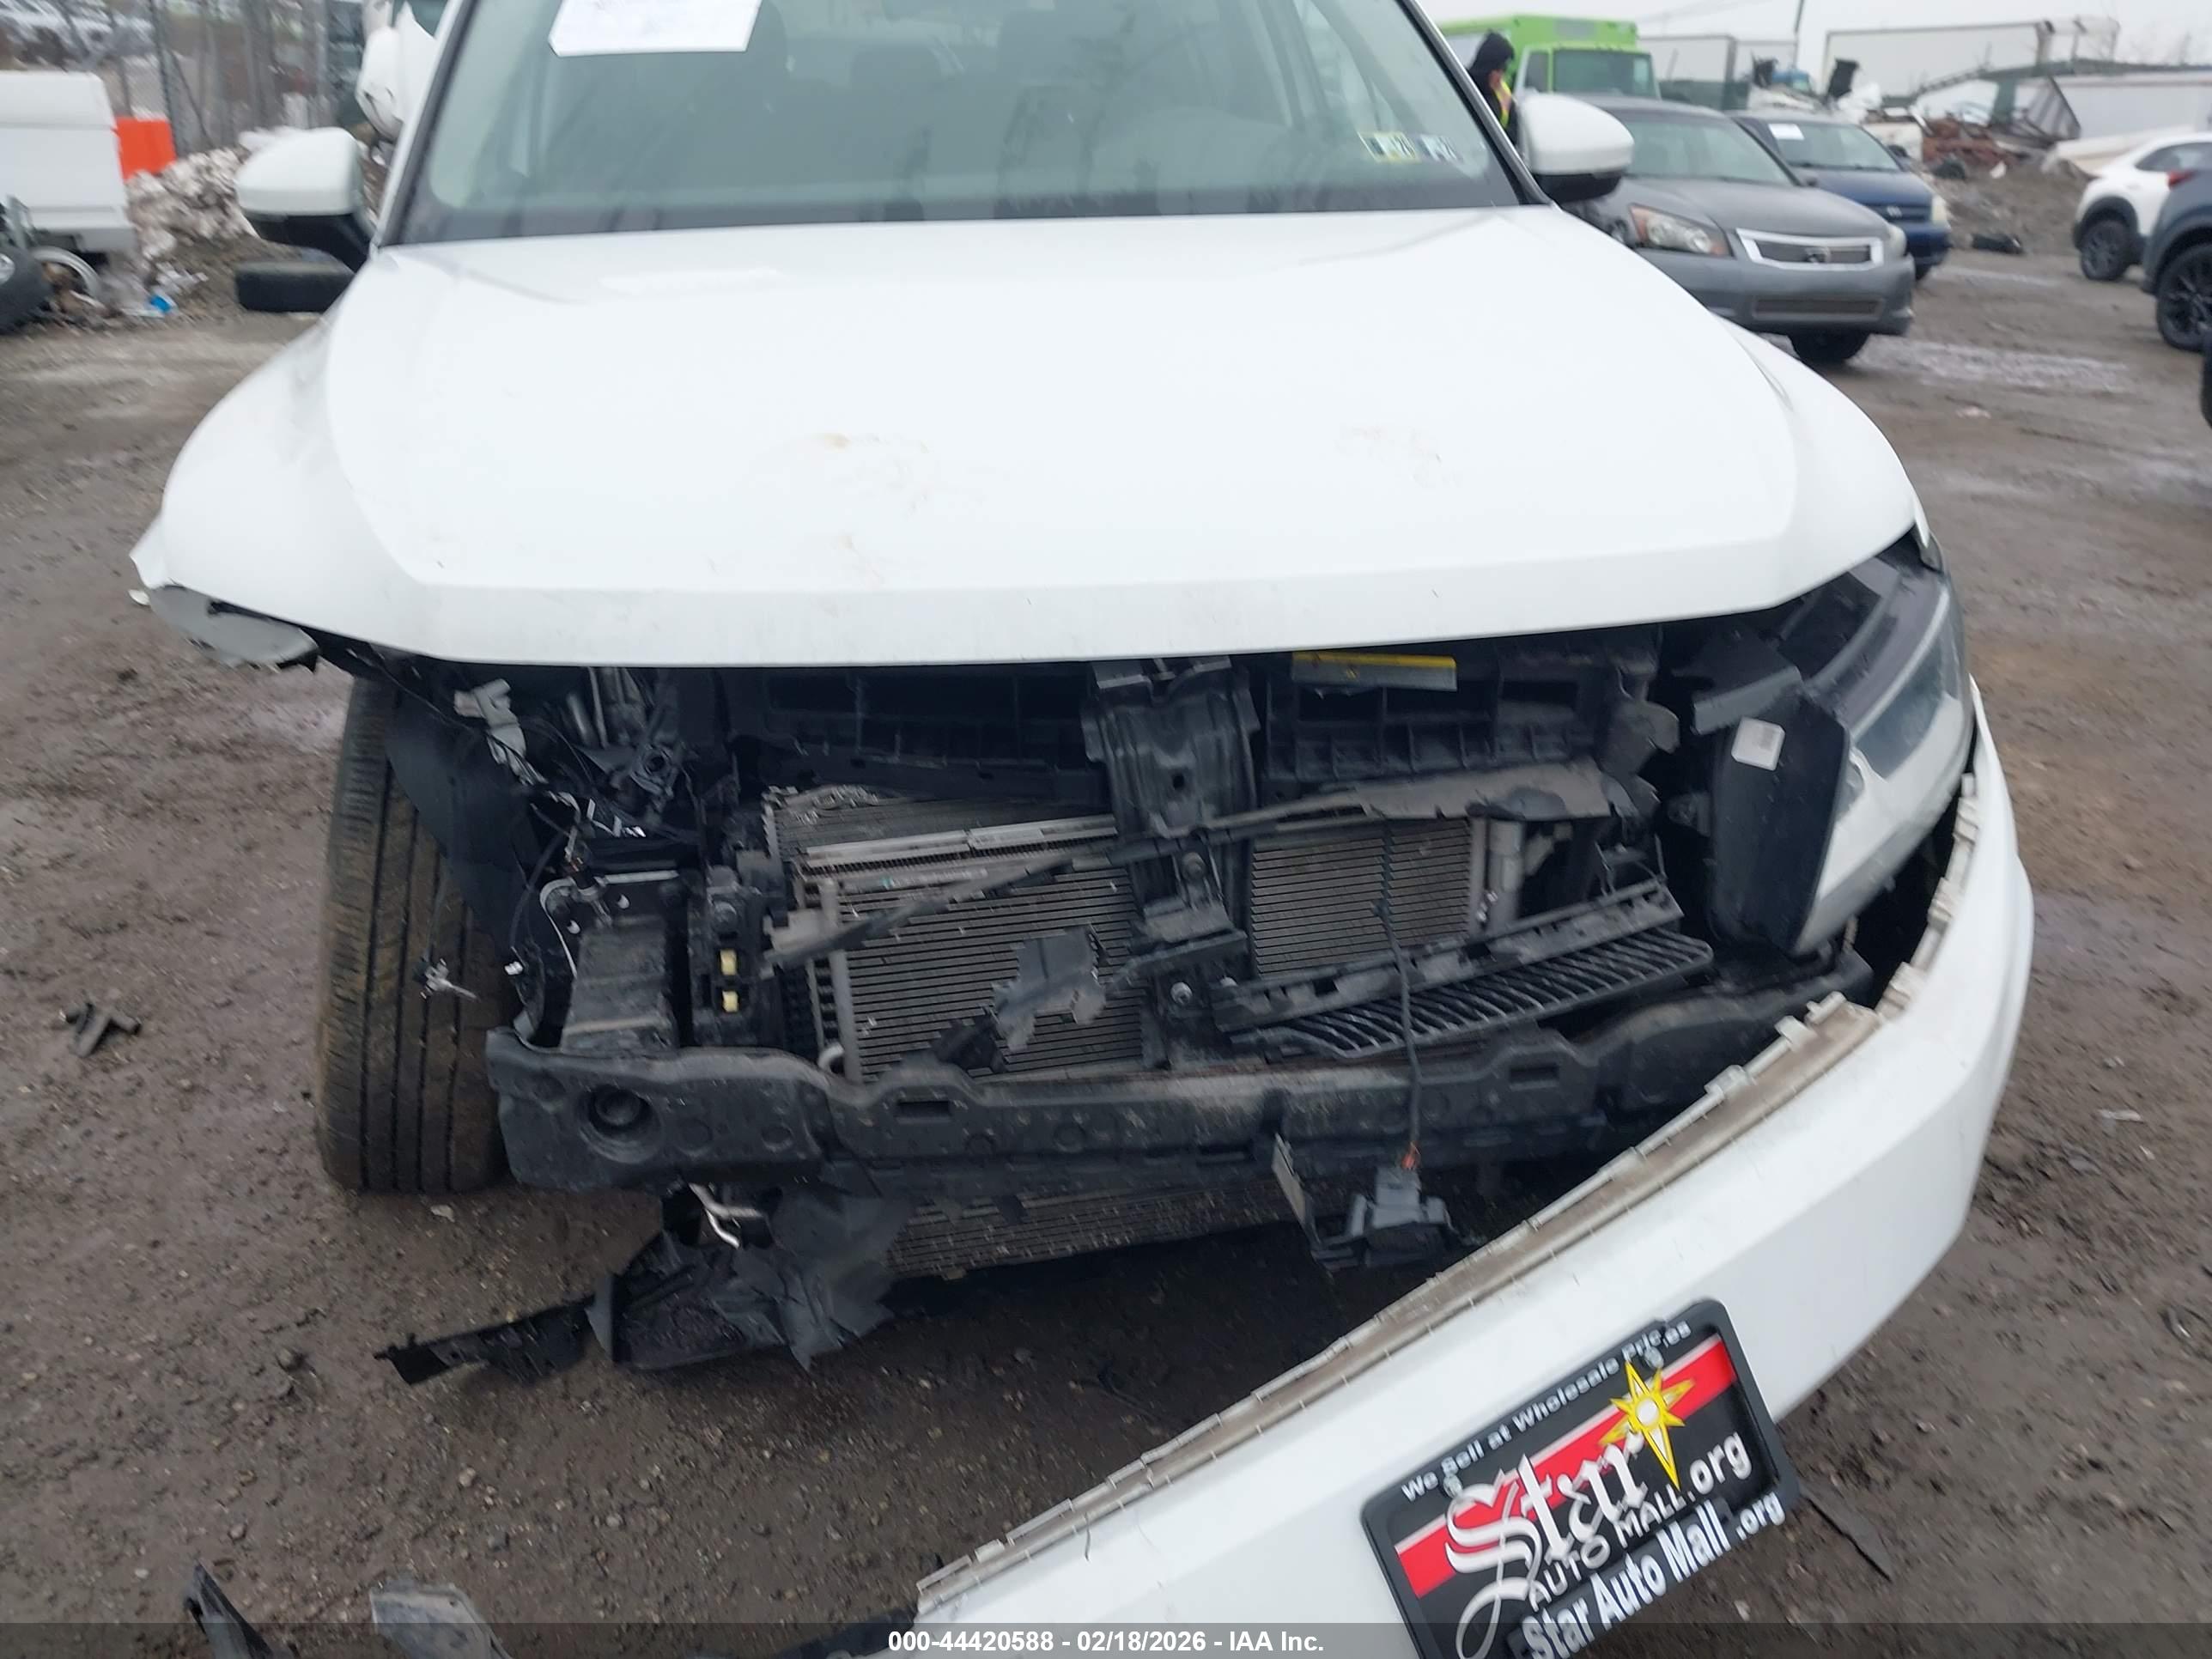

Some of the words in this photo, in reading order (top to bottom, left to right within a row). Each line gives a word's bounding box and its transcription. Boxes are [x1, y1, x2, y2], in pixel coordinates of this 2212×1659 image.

[1401, 1472, 1438, 1502] We
[1487, 1424, 1512, 1449] at
[1512, 1358, 1620, 1432] Wholesale
[1446, 1430, 1646, 1658] Star
[1521, 1597, 1595, 1659] Star
[1590, 1553, 1666, 1631] Auto
[1656, 1499, 1731, 1583] Mall
[1735, 1492, 1786, 1540] .org
[1528, 1534, 1611, 1612] AUTO
